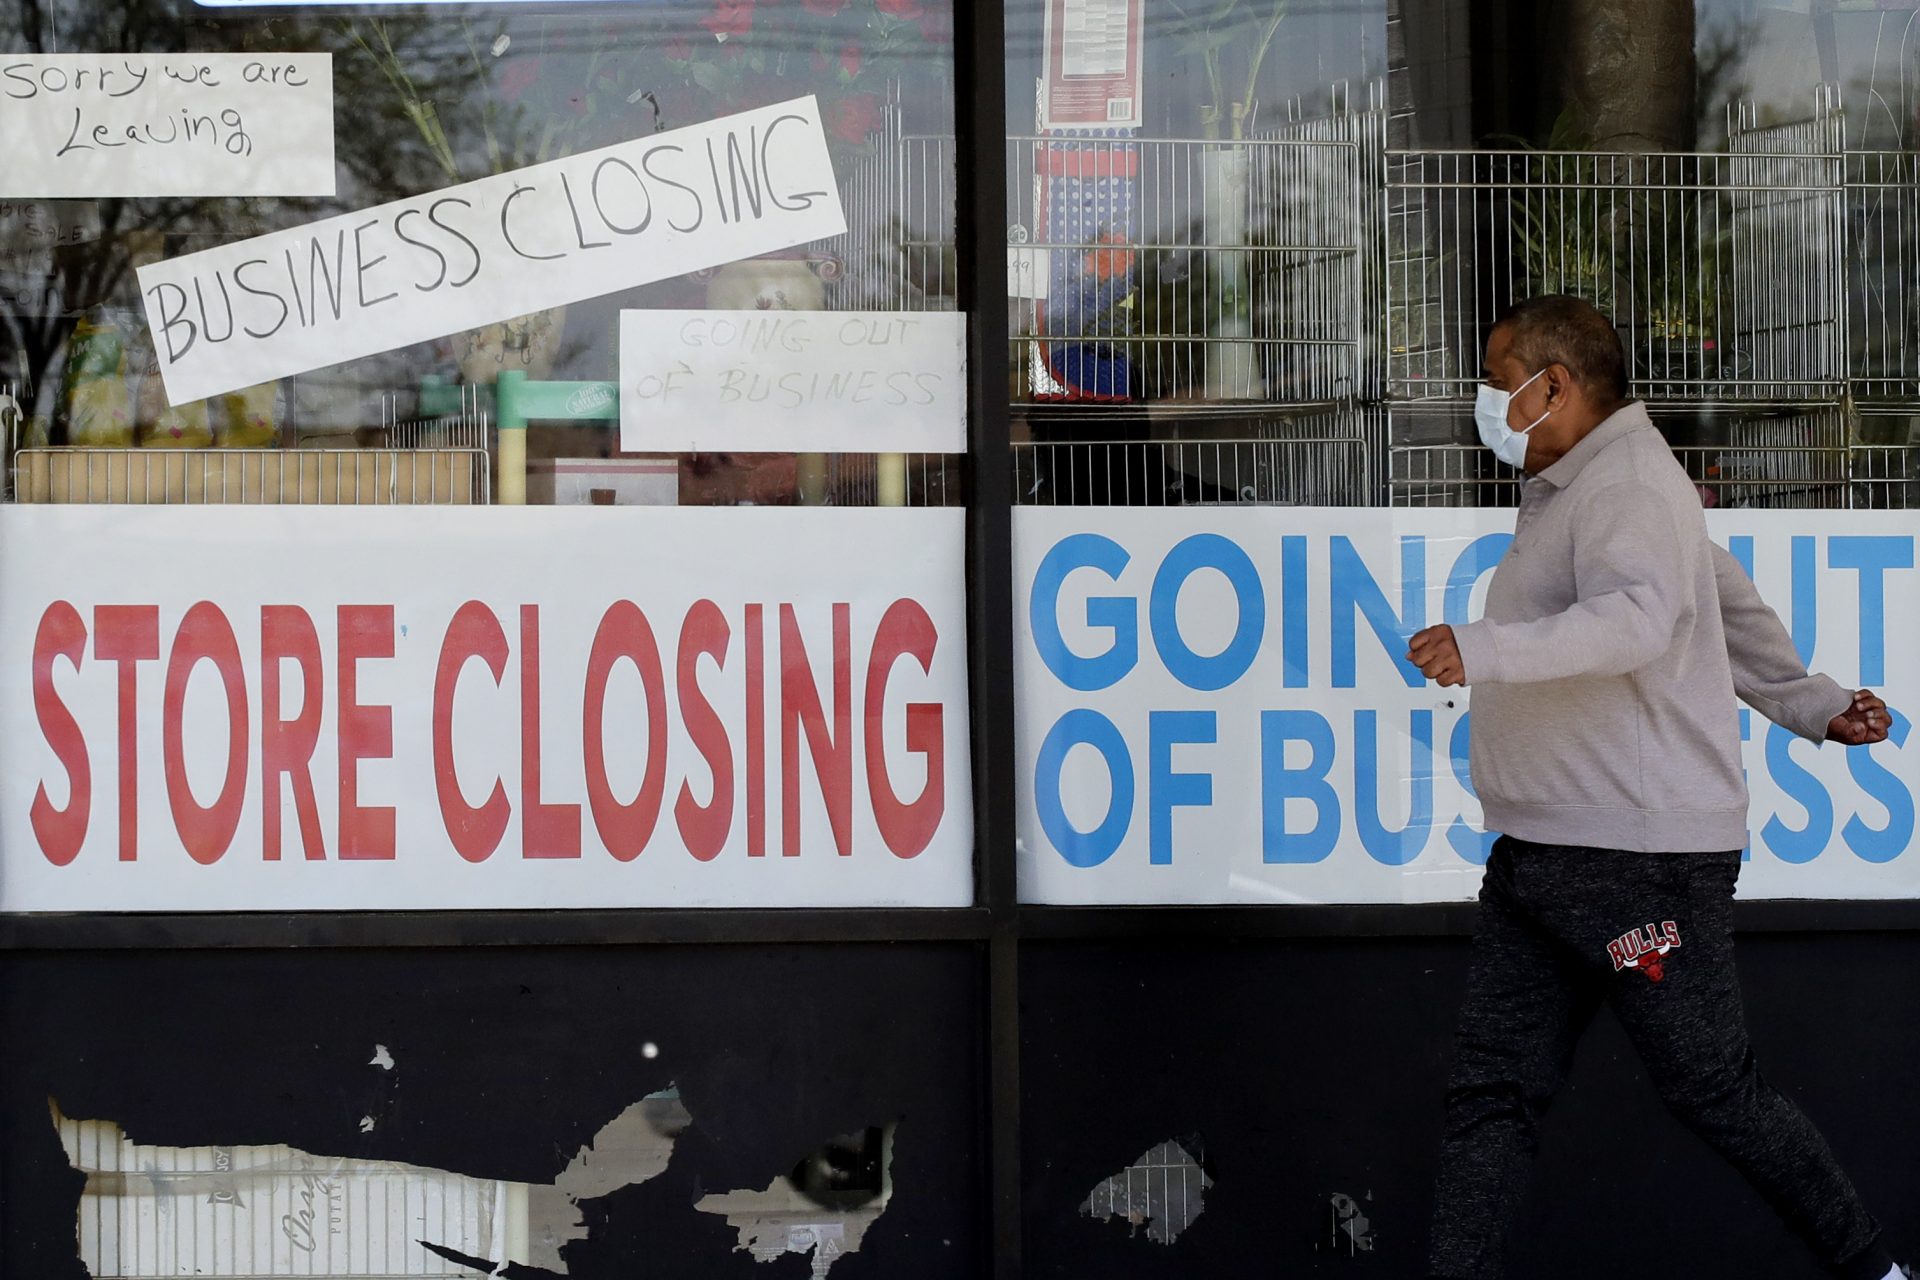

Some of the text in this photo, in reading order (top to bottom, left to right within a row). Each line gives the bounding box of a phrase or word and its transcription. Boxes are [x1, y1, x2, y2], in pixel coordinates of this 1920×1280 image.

[3, 61, 309, 99] Sorry we are
[146, 197, 481, 365] BUSINESS
[500, 114, 829, 260] CLOSING
[636, 367, 943, 410] OF BUSINESS
[680, 317, 921, 354] GOING OUT
[1030, 532, 1916, 692] GOIN UT
[29, 598, 945, 866] STORE CLOSING
[1034, 707, 1218, 868] OF
[1606, 920, 1682, 972] BULLS
